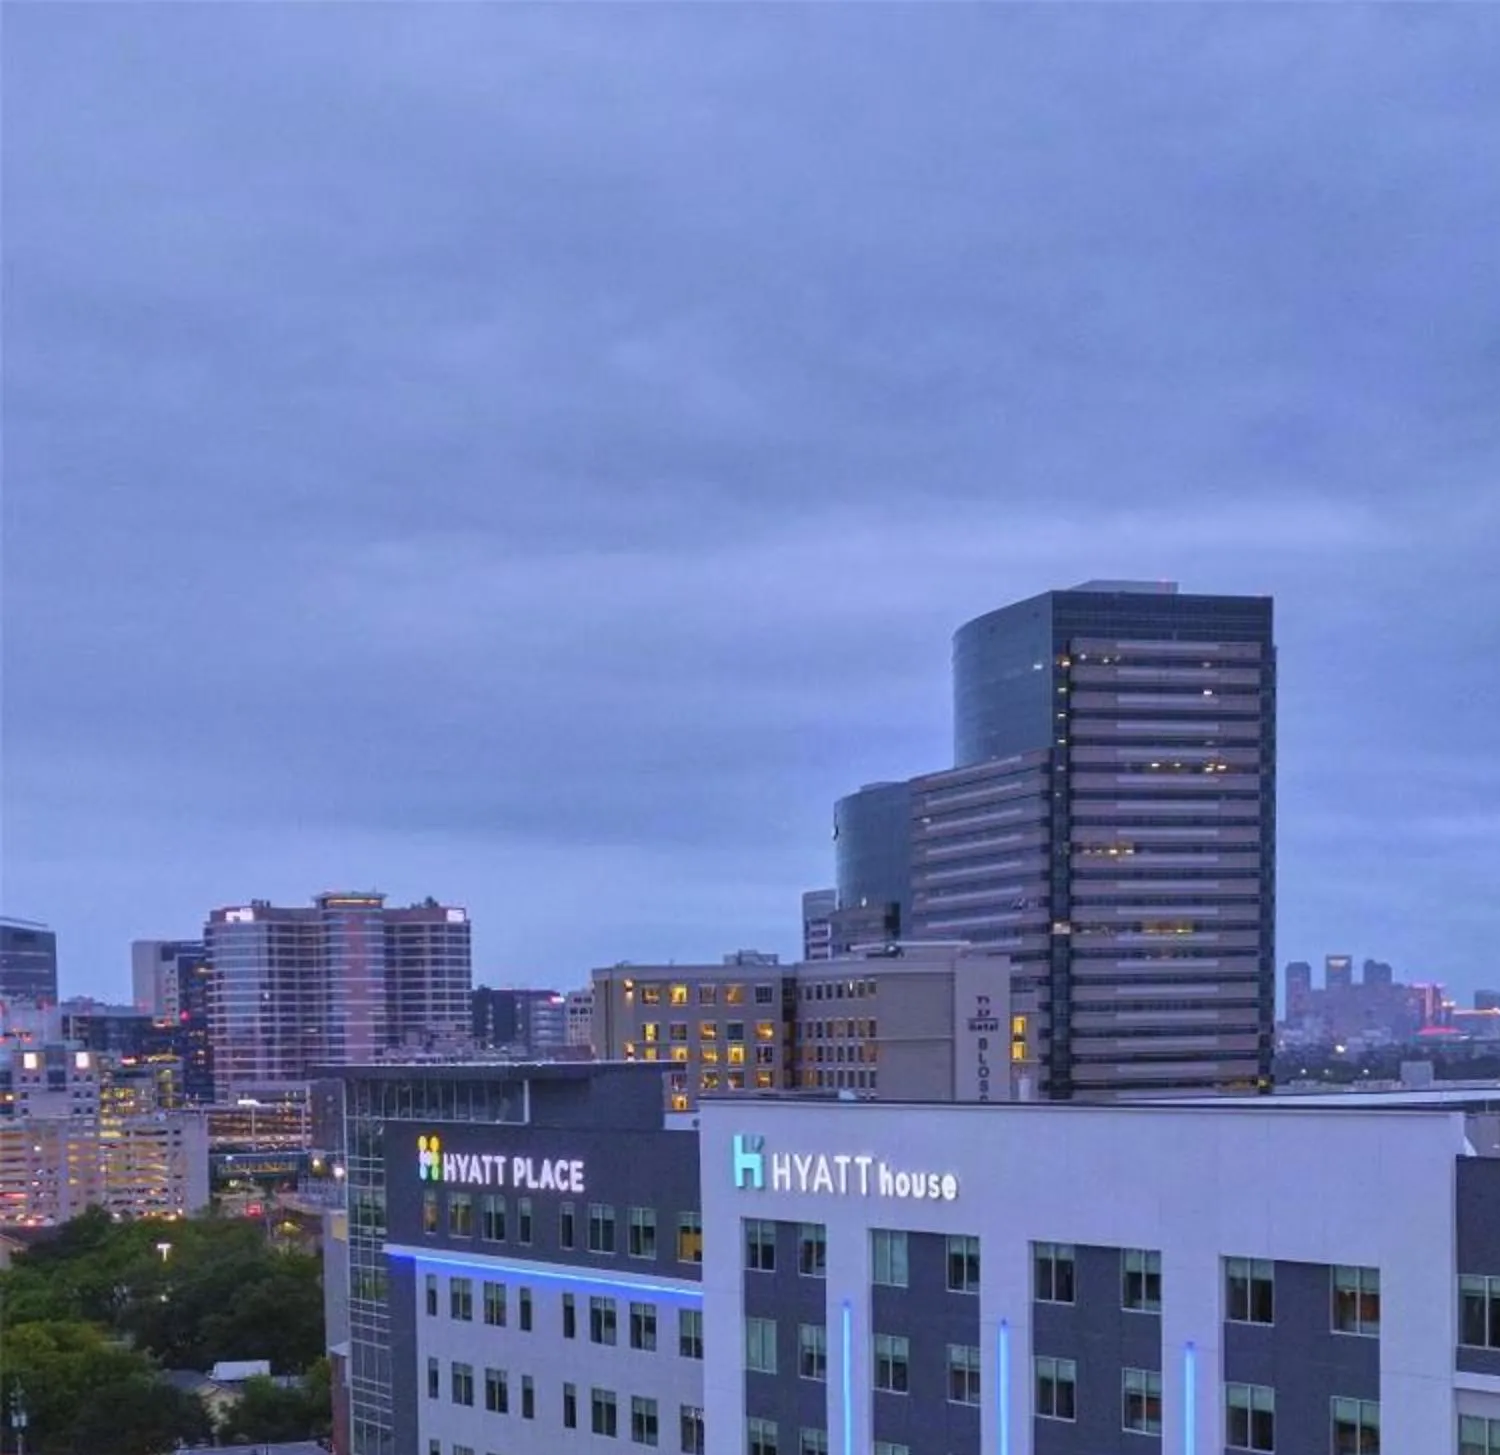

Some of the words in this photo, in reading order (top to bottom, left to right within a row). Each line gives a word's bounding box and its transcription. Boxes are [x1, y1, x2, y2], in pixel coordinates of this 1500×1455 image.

[443, 1152, 507, 1186] HYATT
[513, 1157, 585, 1193] PLACE
[772, 1152, 873, 1195] HYATT
[878, 1162, 958, 1201] house
